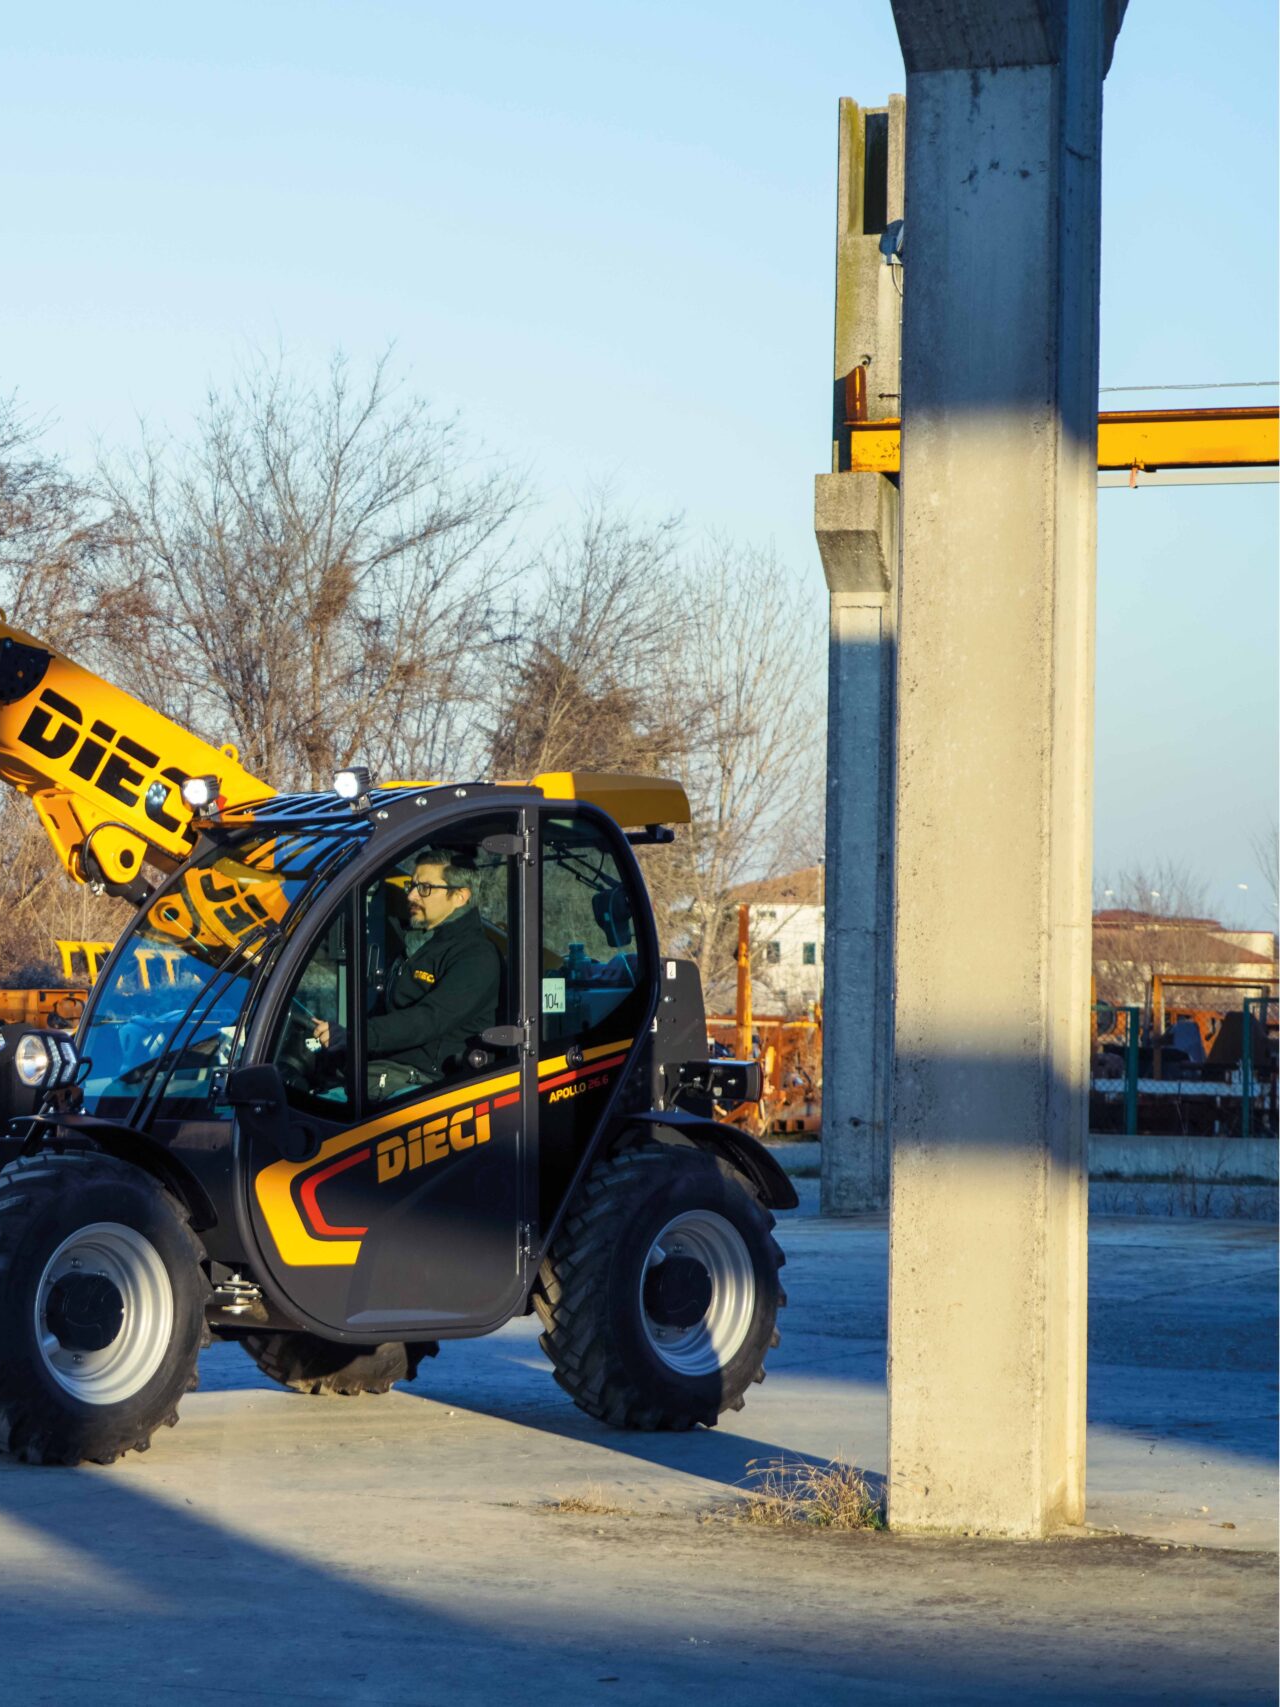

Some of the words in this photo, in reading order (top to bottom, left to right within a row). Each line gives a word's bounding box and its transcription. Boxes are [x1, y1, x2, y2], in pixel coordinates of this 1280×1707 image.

[544, 993, 559, 1009] 104
[548, 1081, 586, 1104] APOLLO
[376, 1101, 491, 1184] DIECI
